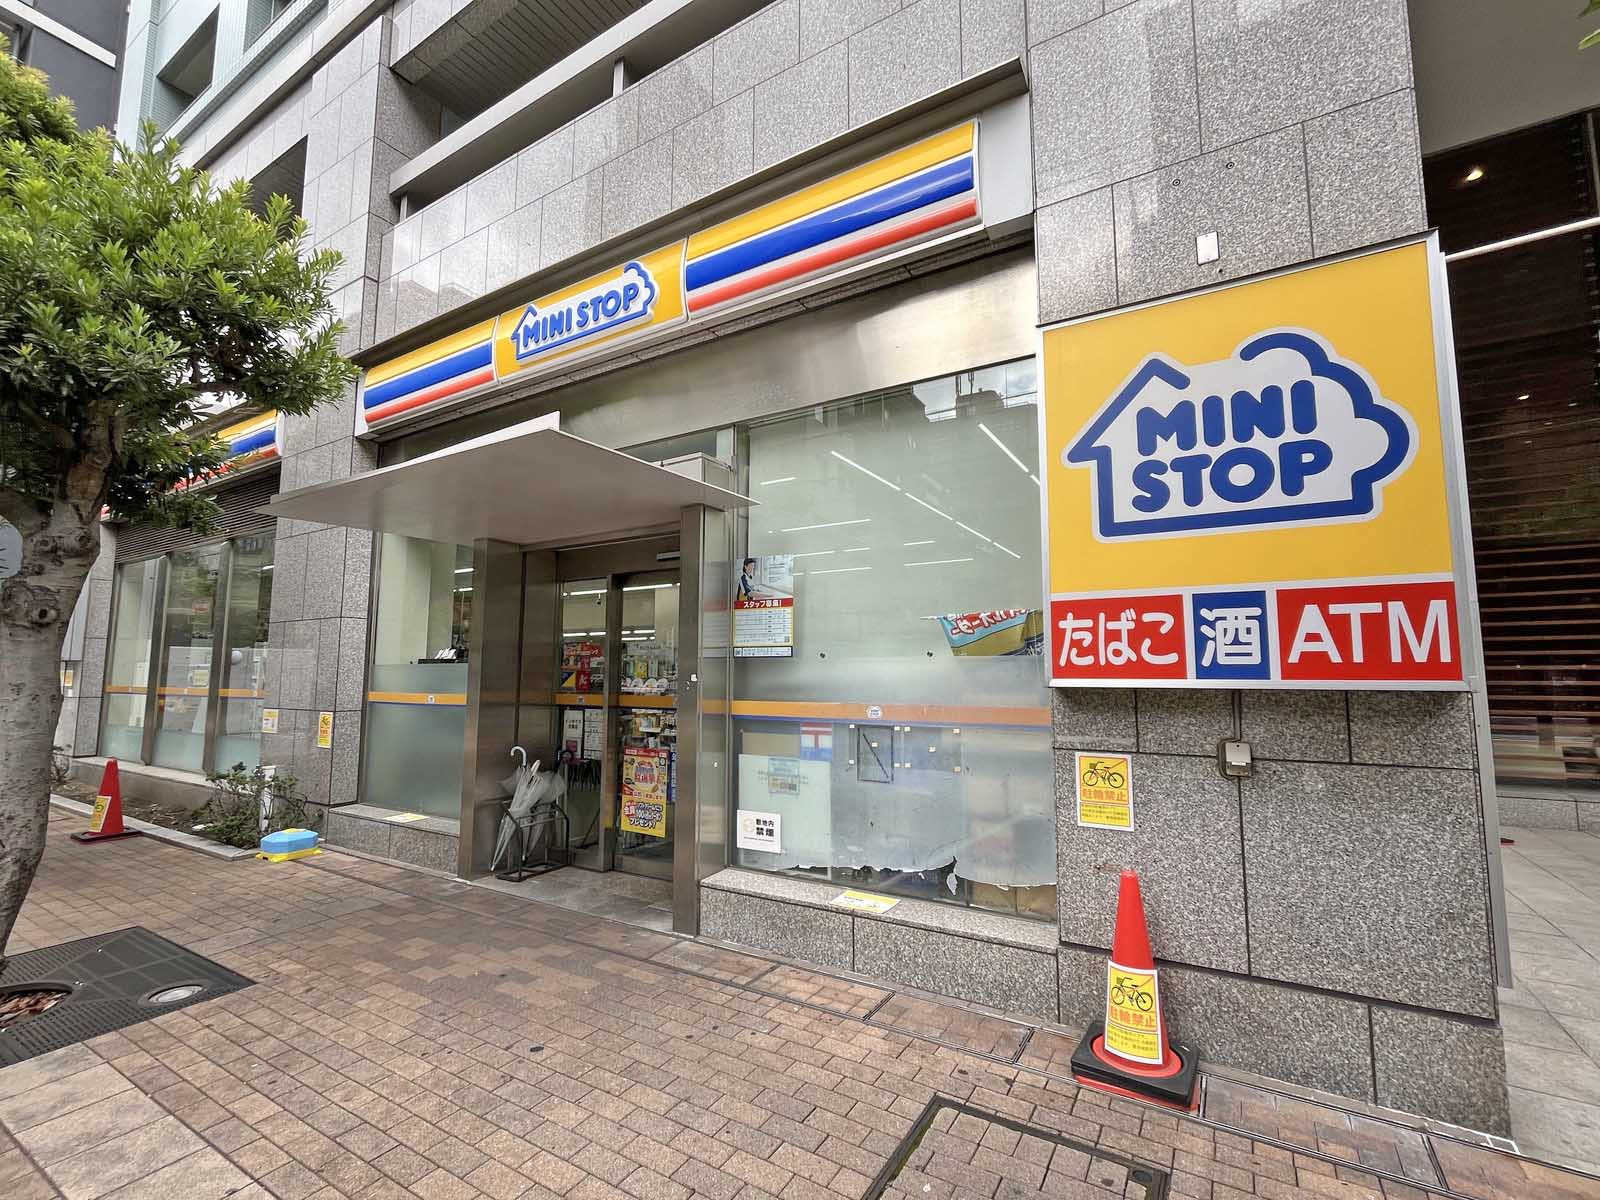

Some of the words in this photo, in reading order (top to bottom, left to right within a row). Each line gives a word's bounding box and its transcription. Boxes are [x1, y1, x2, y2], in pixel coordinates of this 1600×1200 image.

[523, 307, 572, 348] MINI
[576, 282, 639, 328] STOP
[1137, 379, 1317, 456] MINI
[1132, 439, 1333, 512] STOP
[1058, 607, 1179, 667] たばこ
[1200, 607, 1262, 667] 酒
[1288, 600, 1452, 663] ATM
